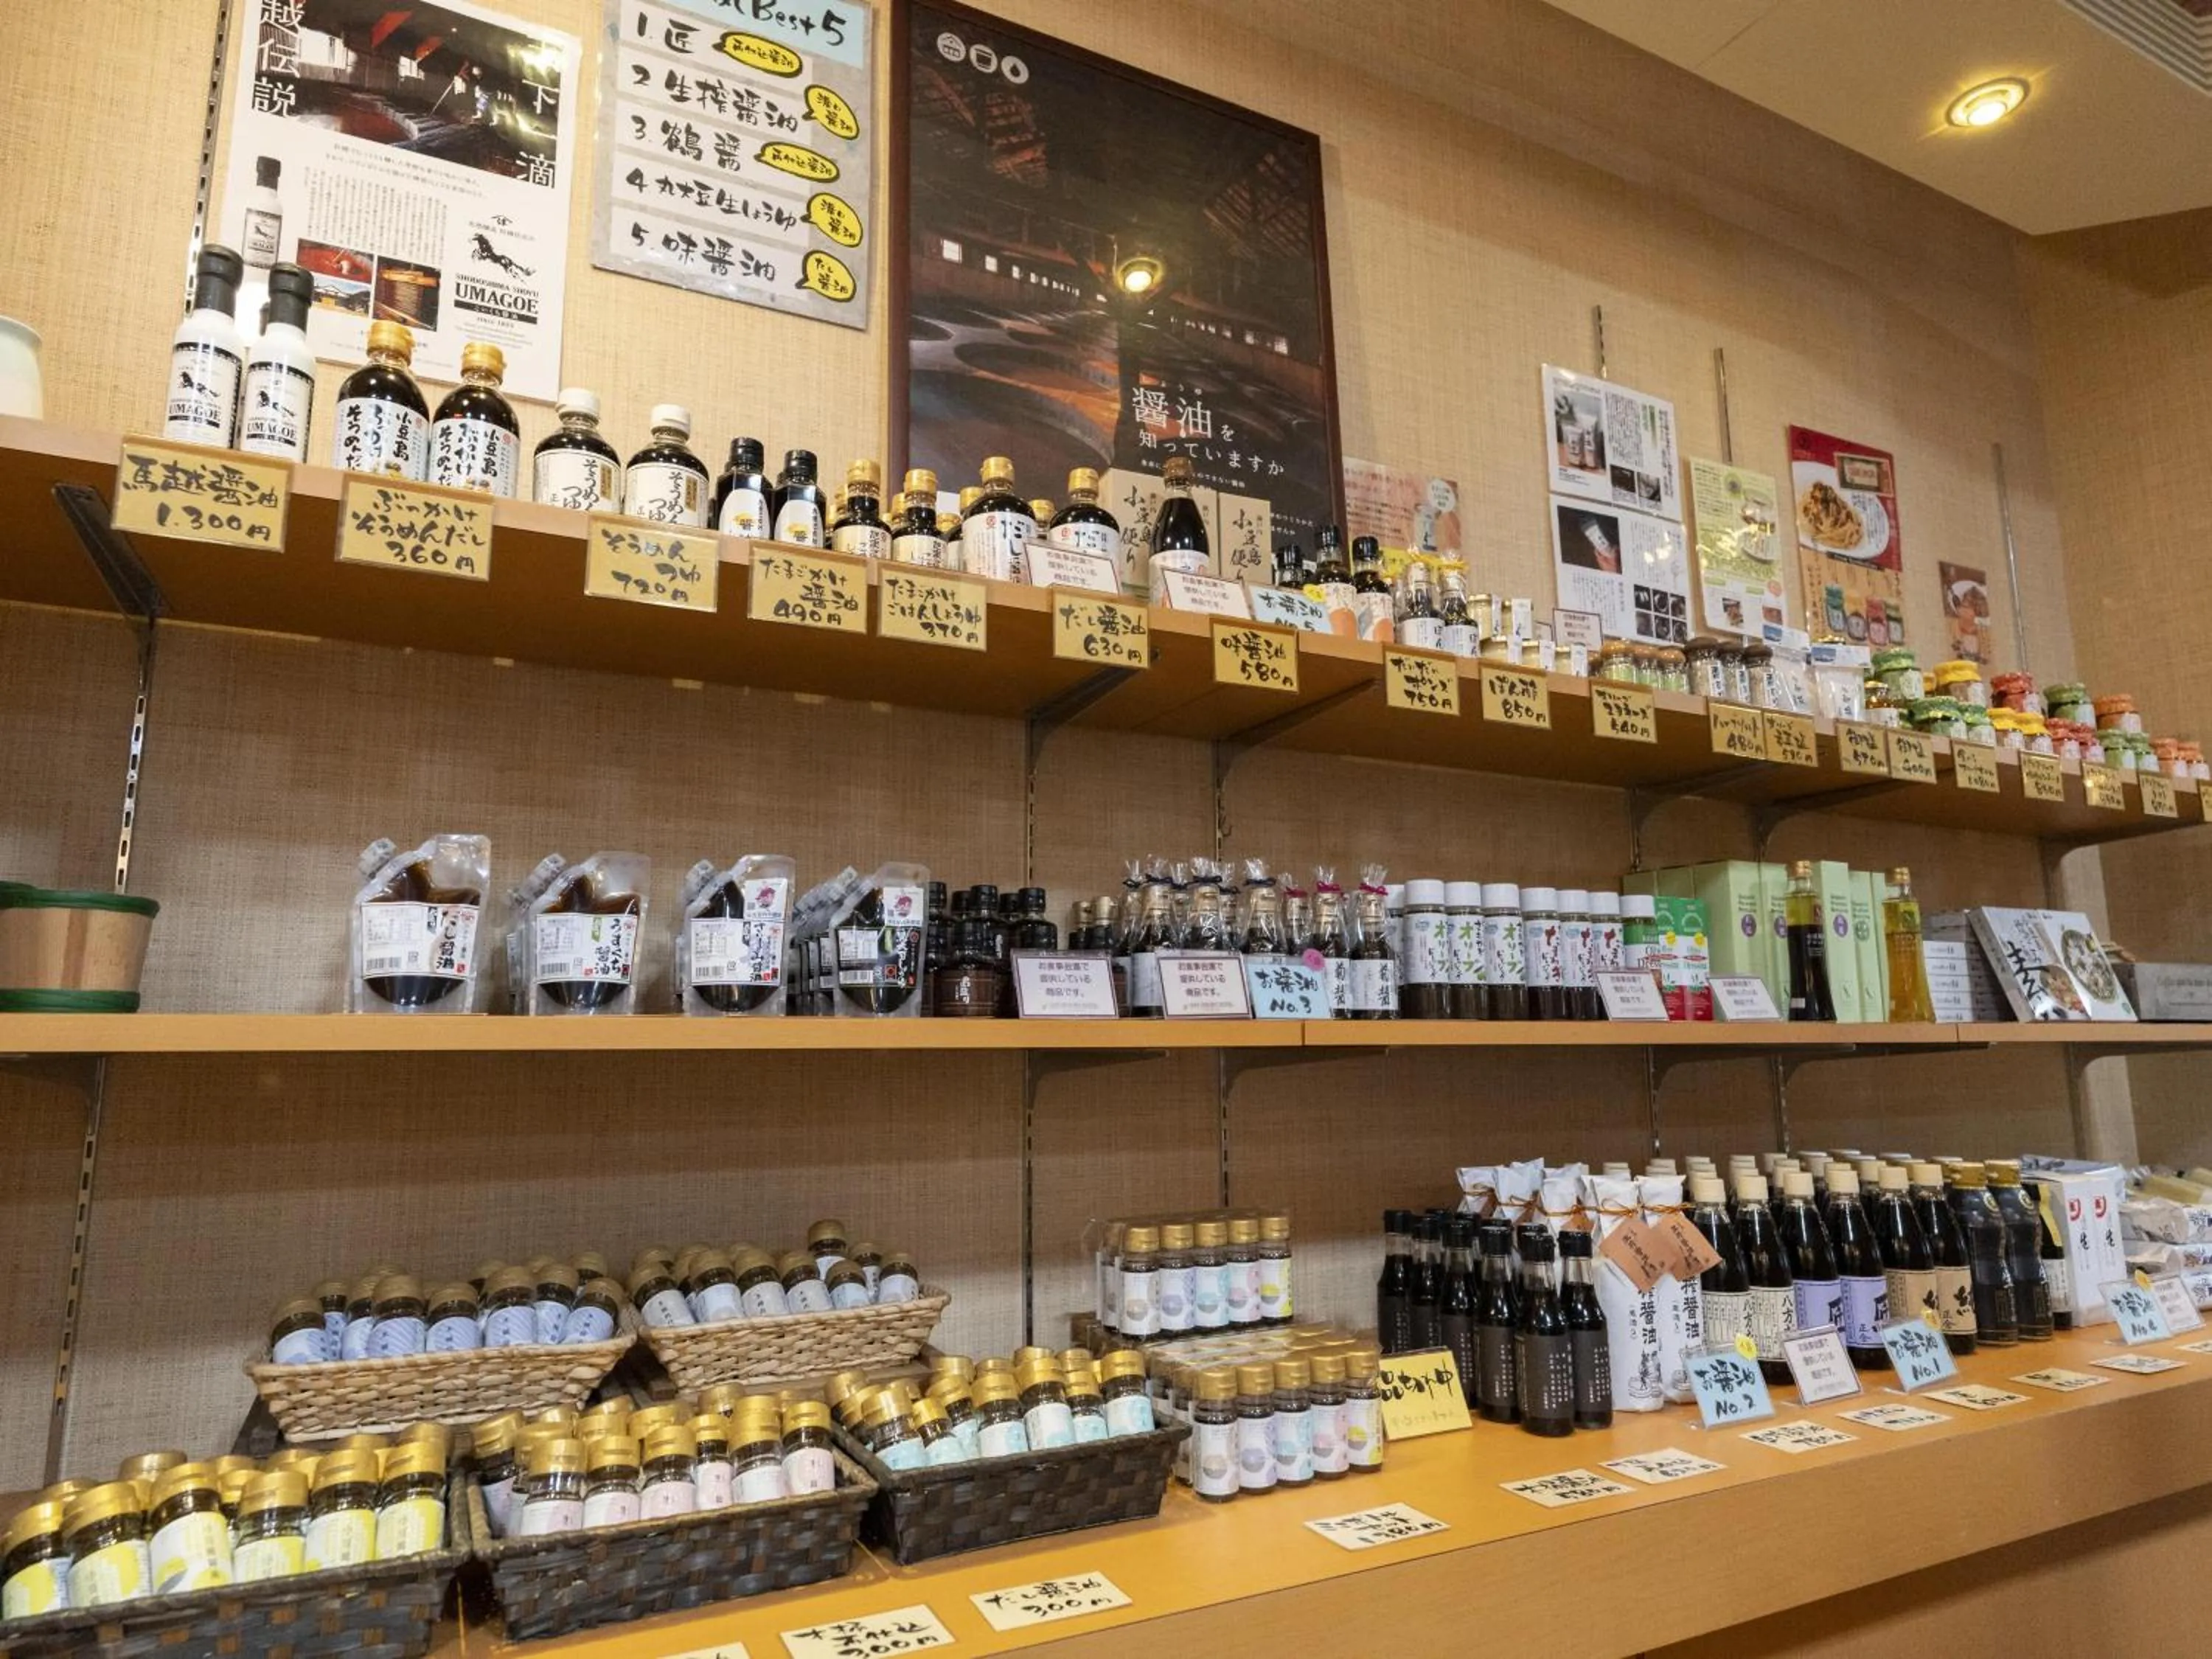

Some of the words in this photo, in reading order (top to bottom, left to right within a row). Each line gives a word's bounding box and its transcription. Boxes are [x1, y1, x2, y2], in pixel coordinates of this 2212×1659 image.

[664, 19, 700, 54] 匠
[821, 9, 846, 46] 5
[455, 282, 539, 315] UMAGOE
[1139, 431, 1284, 476] 知っていますか
[352, 511, 486, 547] そうめんだし
[386, 541, 475, 574] 360円
[774, 599, 841, 626] 490円
[1059, 603, 1146, 636] だし醤油
[1083, 633, 1142, 663] 630円
[1501, 698, 1547, 723] 850円
